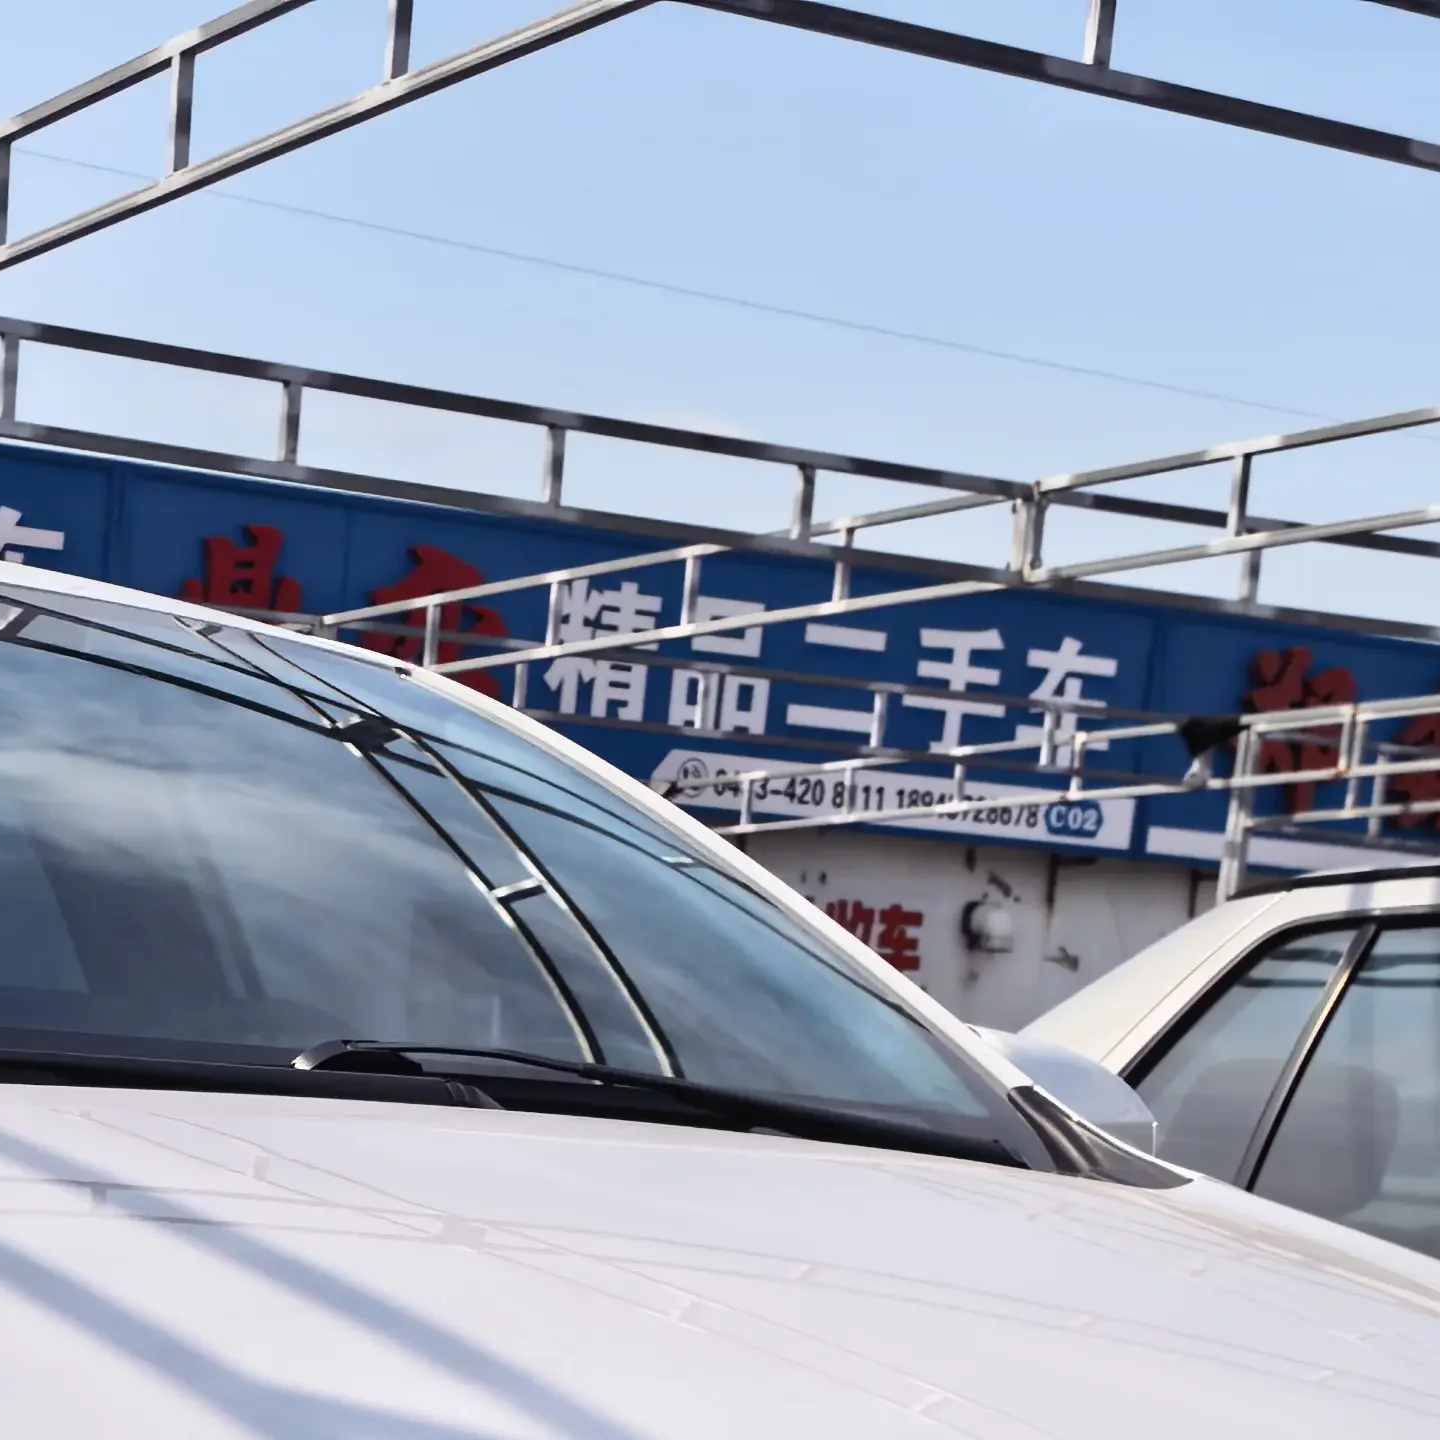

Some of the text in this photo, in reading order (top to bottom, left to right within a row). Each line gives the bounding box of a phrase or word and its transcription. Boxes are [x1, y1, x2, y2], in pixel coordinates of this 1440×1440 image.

[544, 578, 1119, 769] 精品二手车
[1049, 804, 1099, 832] C02
